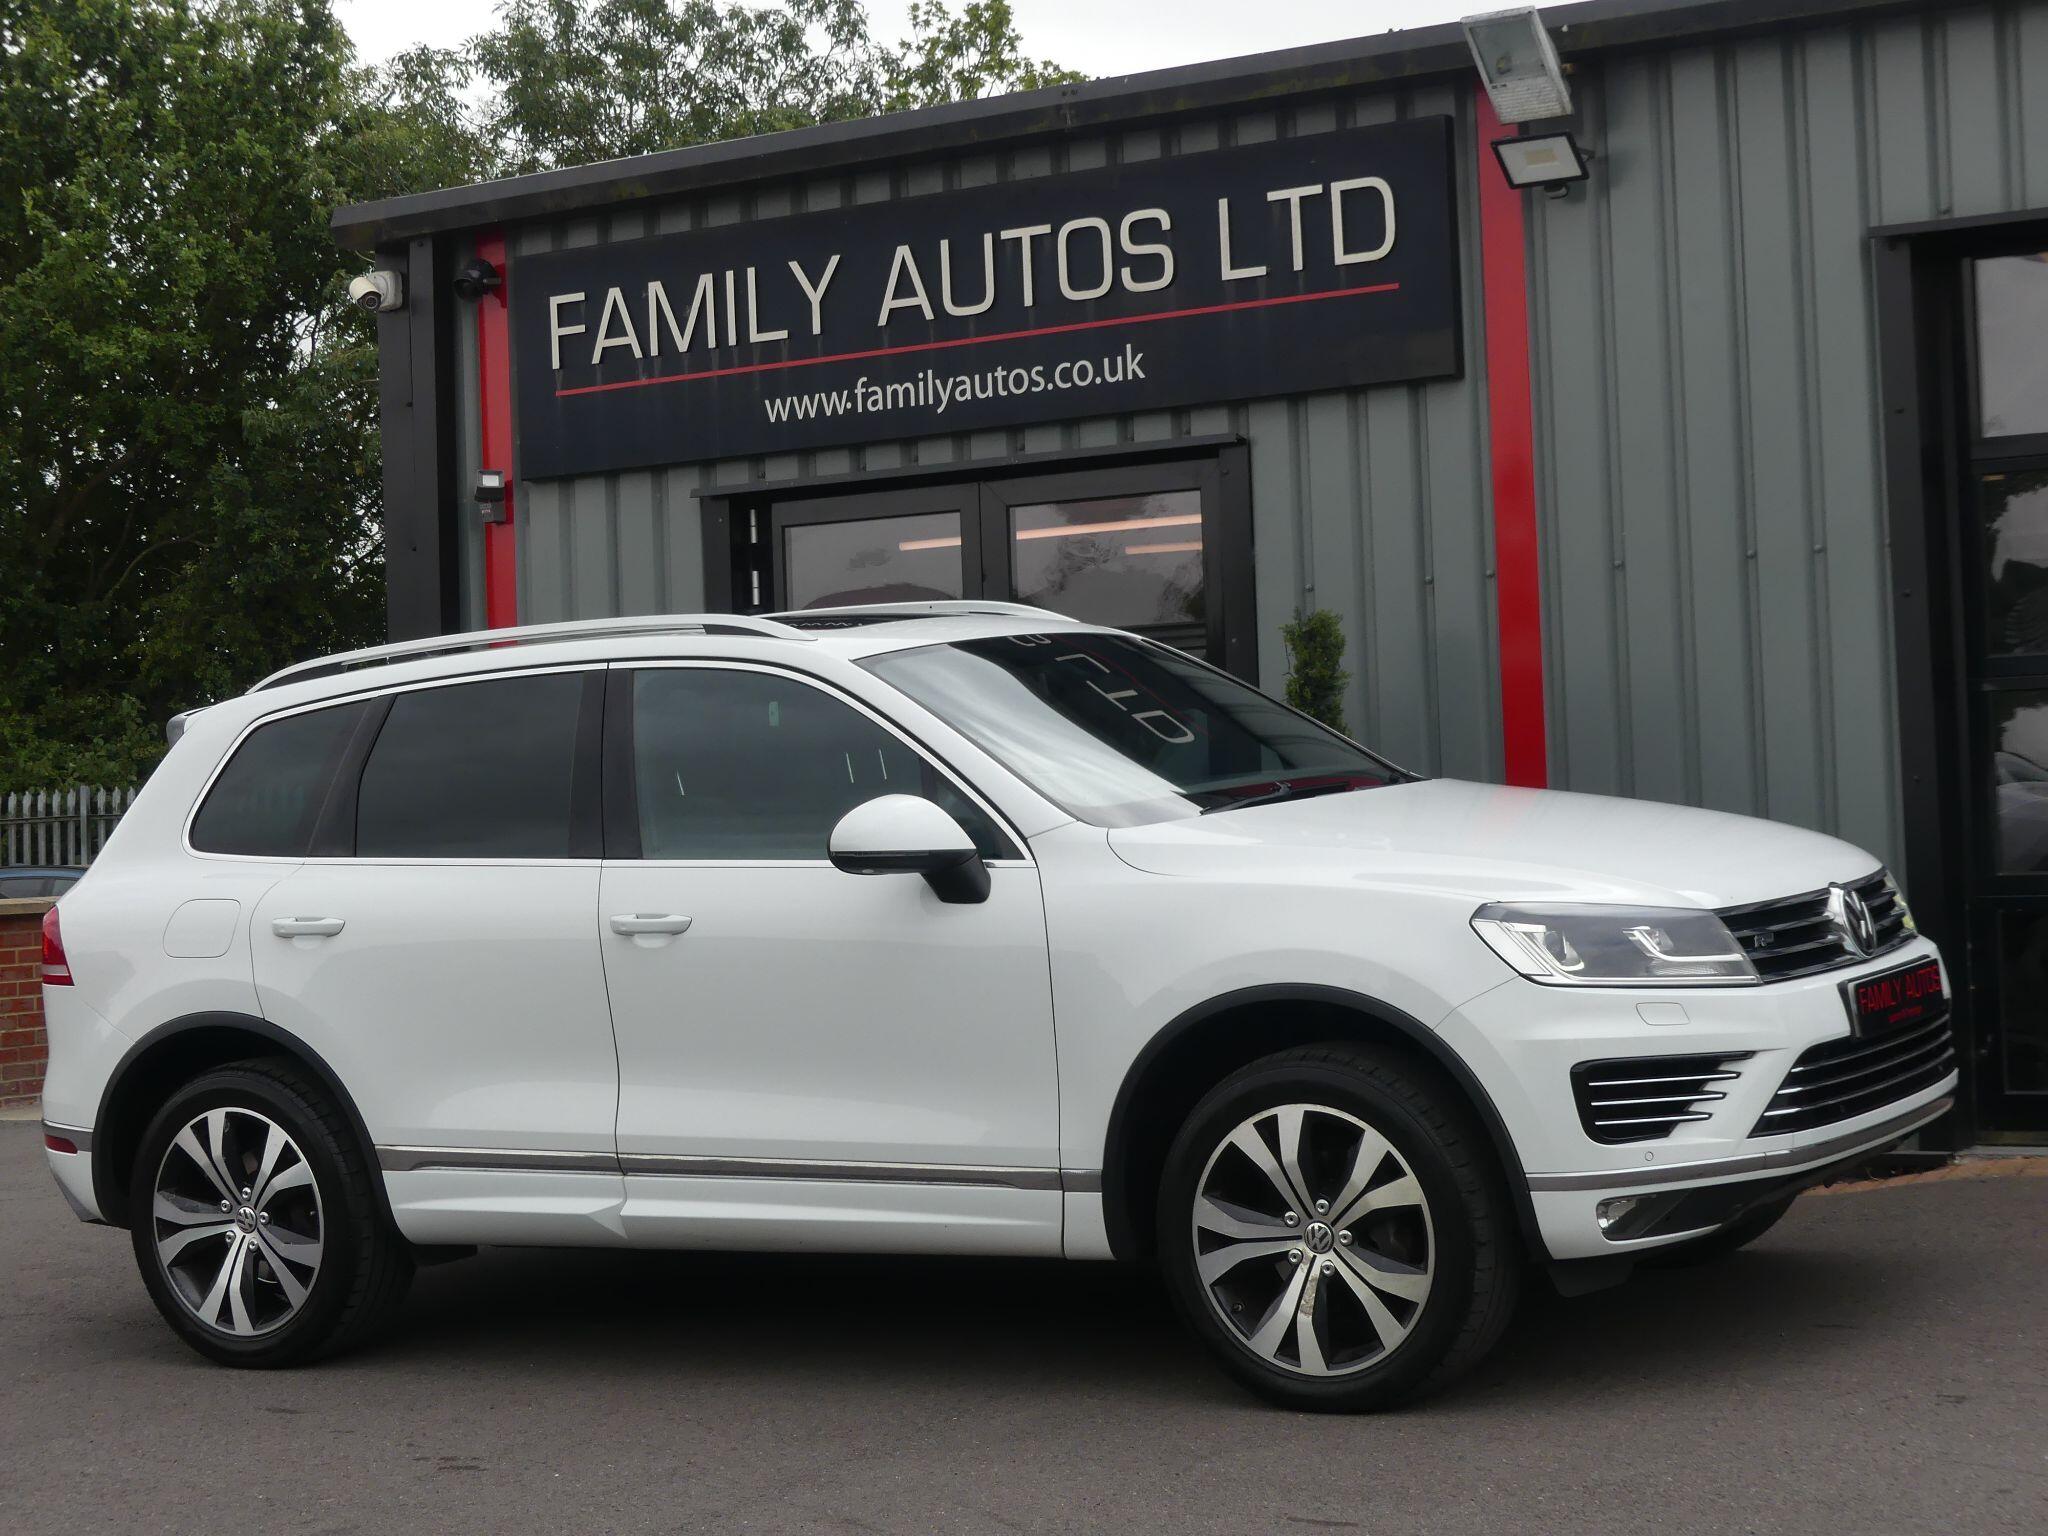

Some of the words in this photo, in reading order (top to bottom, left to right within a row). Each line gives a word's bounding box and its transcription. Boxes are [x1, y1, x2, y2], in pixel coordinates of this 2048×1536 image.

[549, 254, 841, 370] FAMILY
[876, 207, 1175, 328] AUTOS
[1217, 175, 1397, 281] LTD
[764, 343, 1146, 424] www.familyautos.co.uk
[1857, 977, 1904, 1014] FAMILY
[1902, 965, 1943, 998] AUTOS
